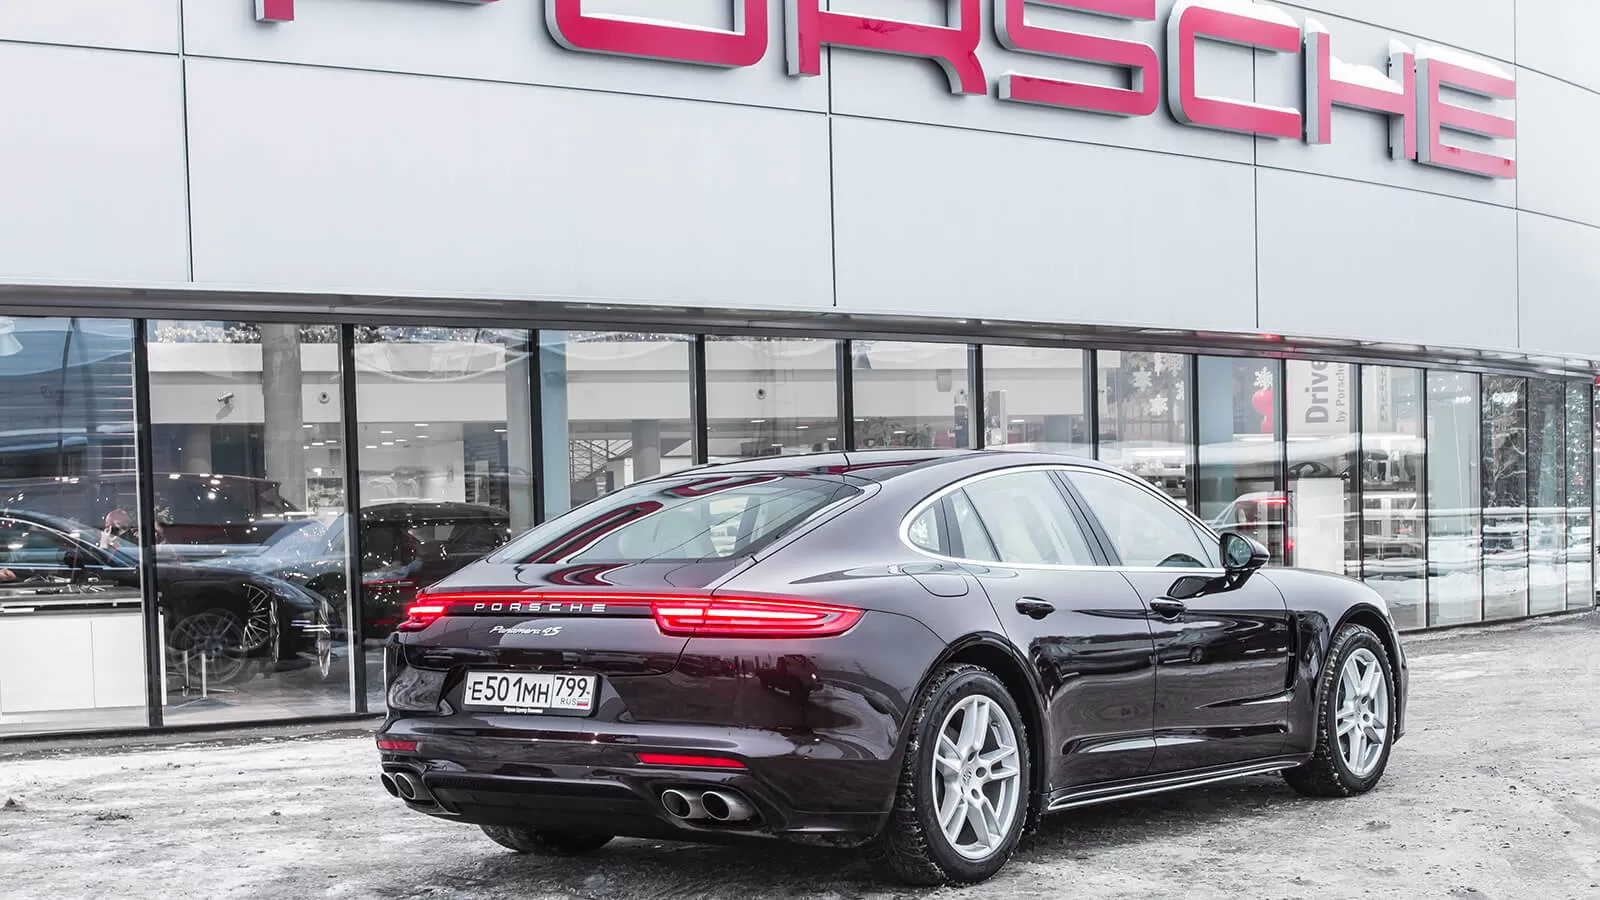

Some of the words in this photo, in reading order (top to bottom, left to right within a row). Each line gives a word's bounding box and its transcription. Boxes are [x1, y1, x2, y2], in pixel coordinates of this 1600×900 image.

[256, 0, 1515, 179] RSCHE
[1305, 361, 1329, 423] Drive
[1336, 410, 1347, 423] by
[473, 602, 606, 612] PORSCHE
[489, 625, 541, 635] Panamera
[542, 626, 563, 636] 4S
[471, 676, 550, 703] E501MH
[556, 676, 588, 697] 799
